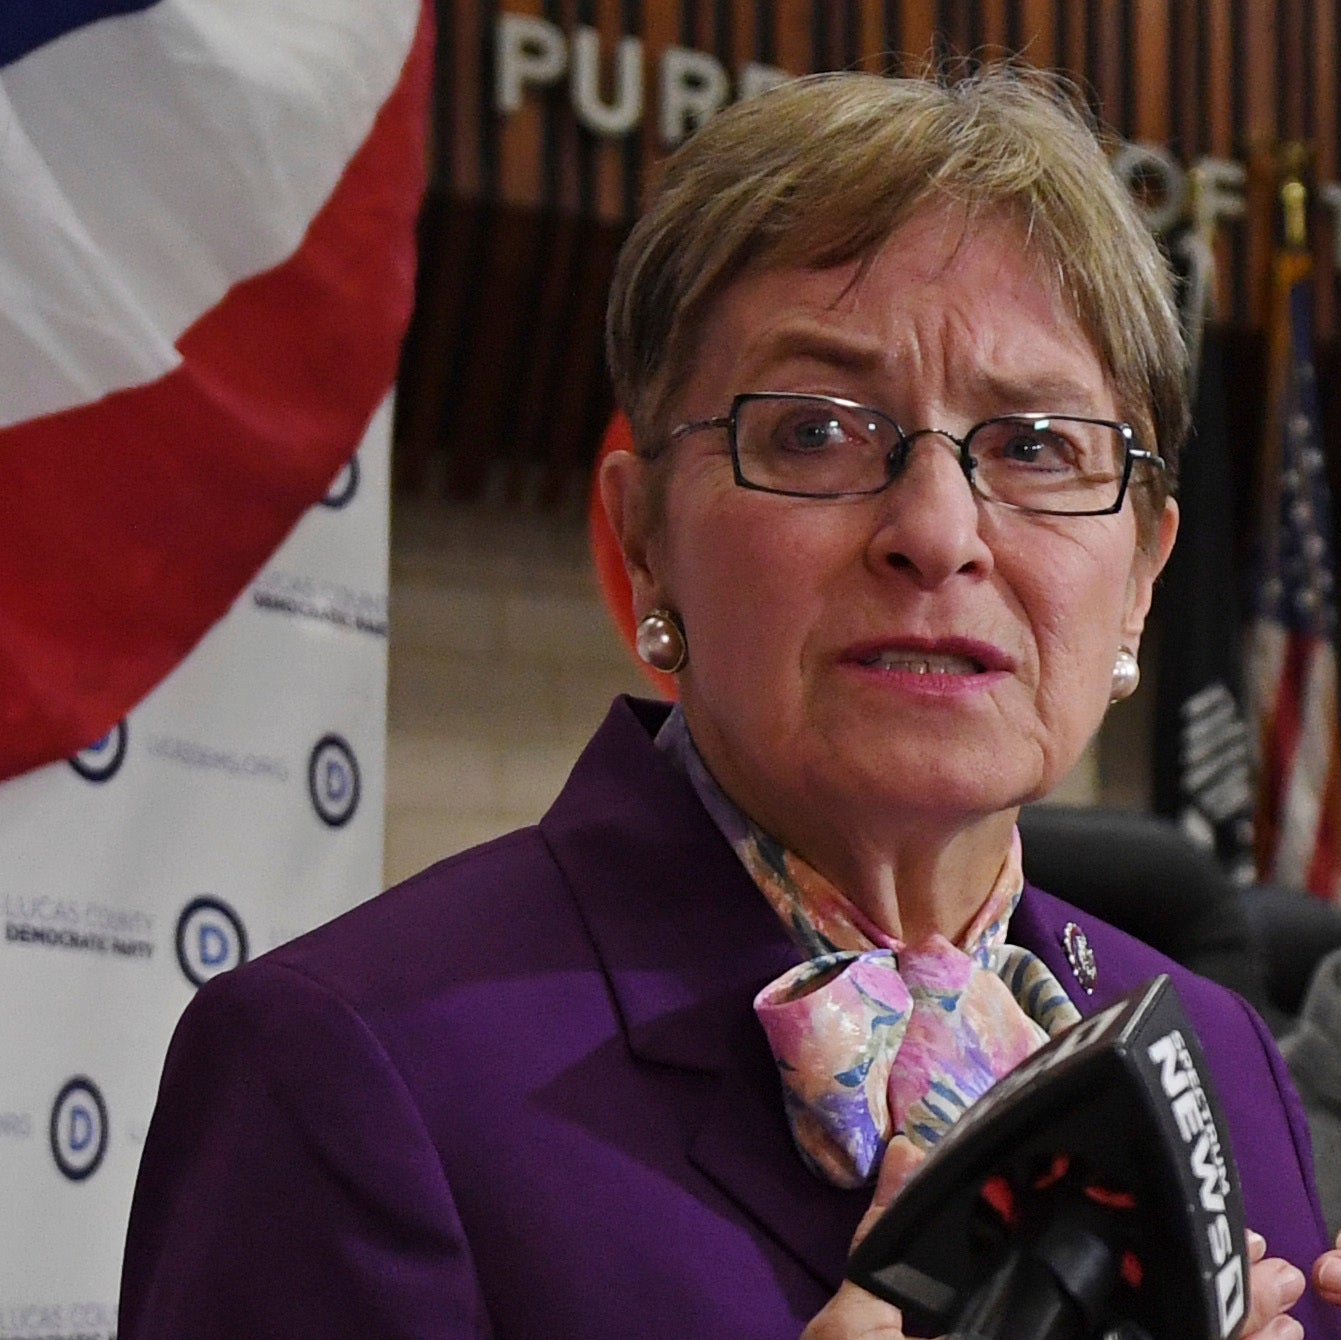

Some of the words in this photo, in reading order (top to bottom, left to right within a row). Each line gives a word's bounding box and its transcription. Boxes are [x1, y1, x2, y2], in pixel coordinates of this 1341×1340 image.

[497, 12, 797, 143] PUR
[200, 924, 230, 967] D
[69, 1105, 93, 1152] D
[1148, 1036, 1233, 1268] NEWS
